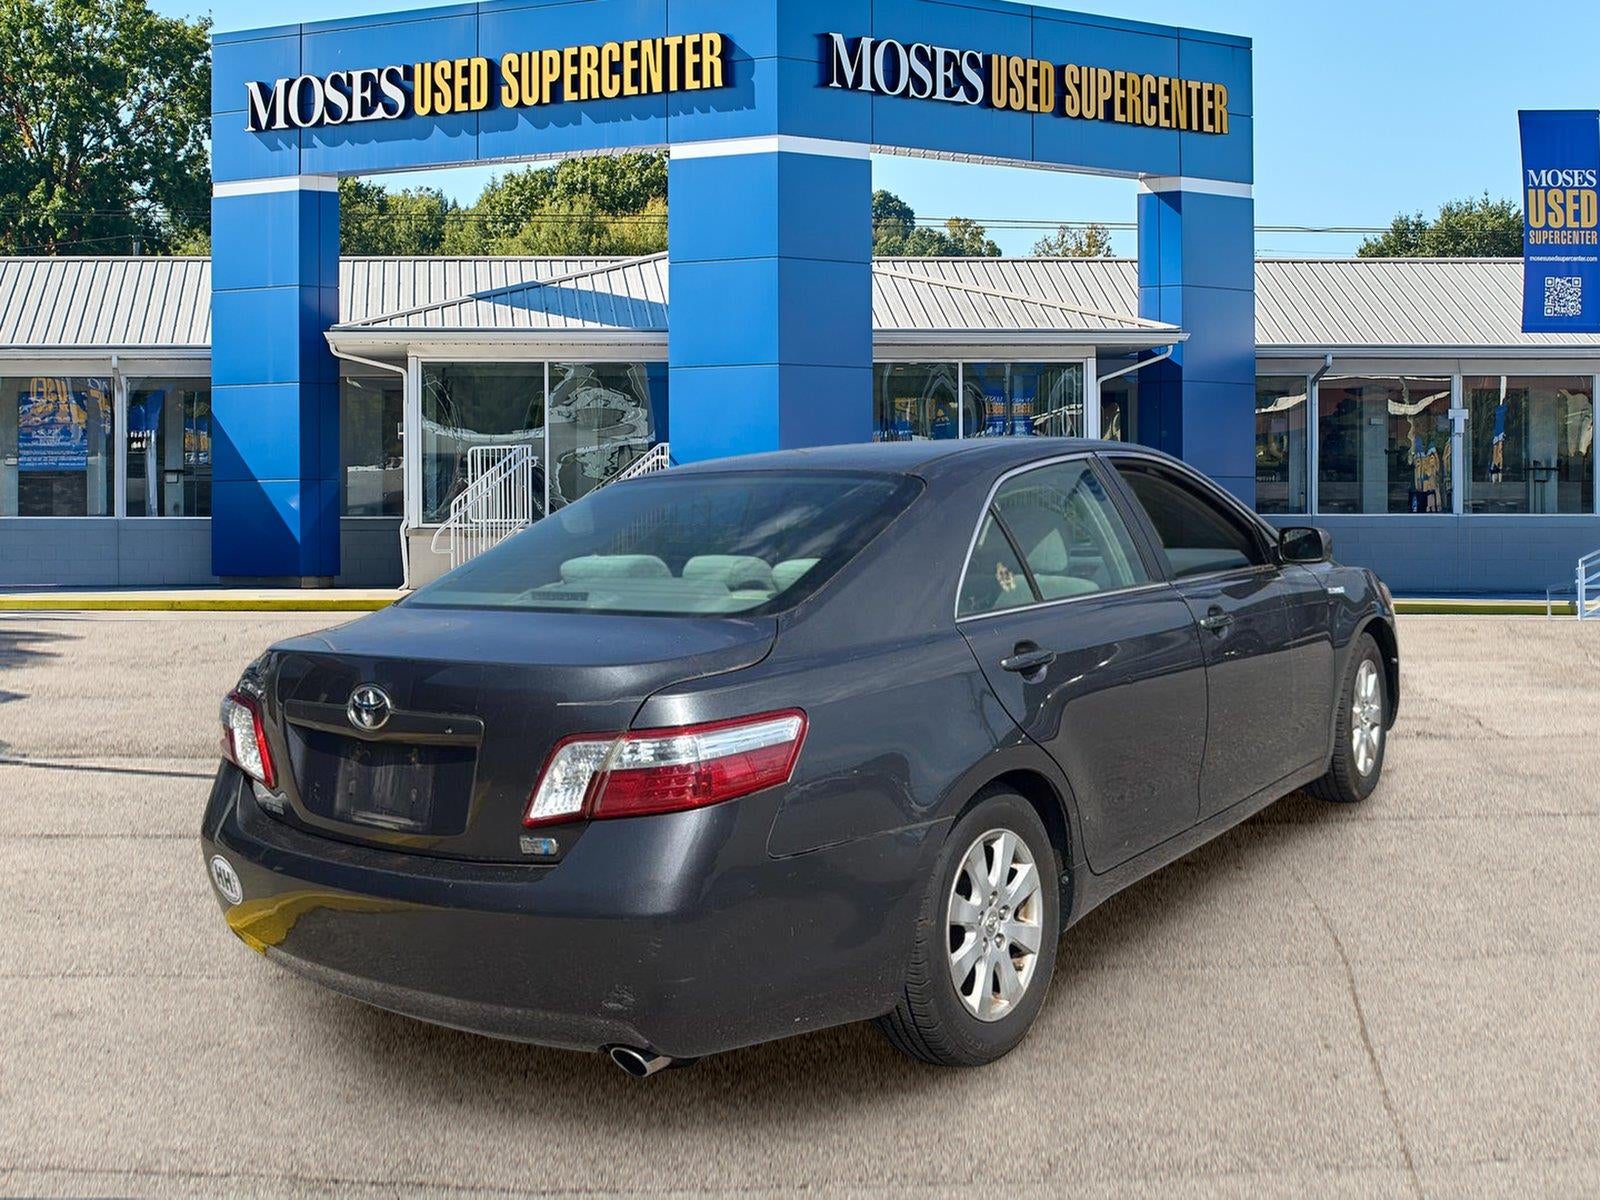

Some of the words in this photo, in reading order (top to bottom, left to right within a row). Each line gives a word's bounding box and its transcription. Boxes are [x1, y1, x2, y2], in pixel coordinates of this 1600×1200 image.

[245, 65, 407, 132] MOSES
[413, 57, 488, 117] USED
[500, 32, 723, 108] SUPERCENTER
[829, 32, 984, 105] MOSES
[990, 54, 1054, 113] USED
[1064, 64, 1229, 134] SUPERCENTER
[1527, 169, 1597, 187] MOSES
[1528, 188, 1598, 229] USED
[1529, 230, 1598, 245] SUPERCENTER
